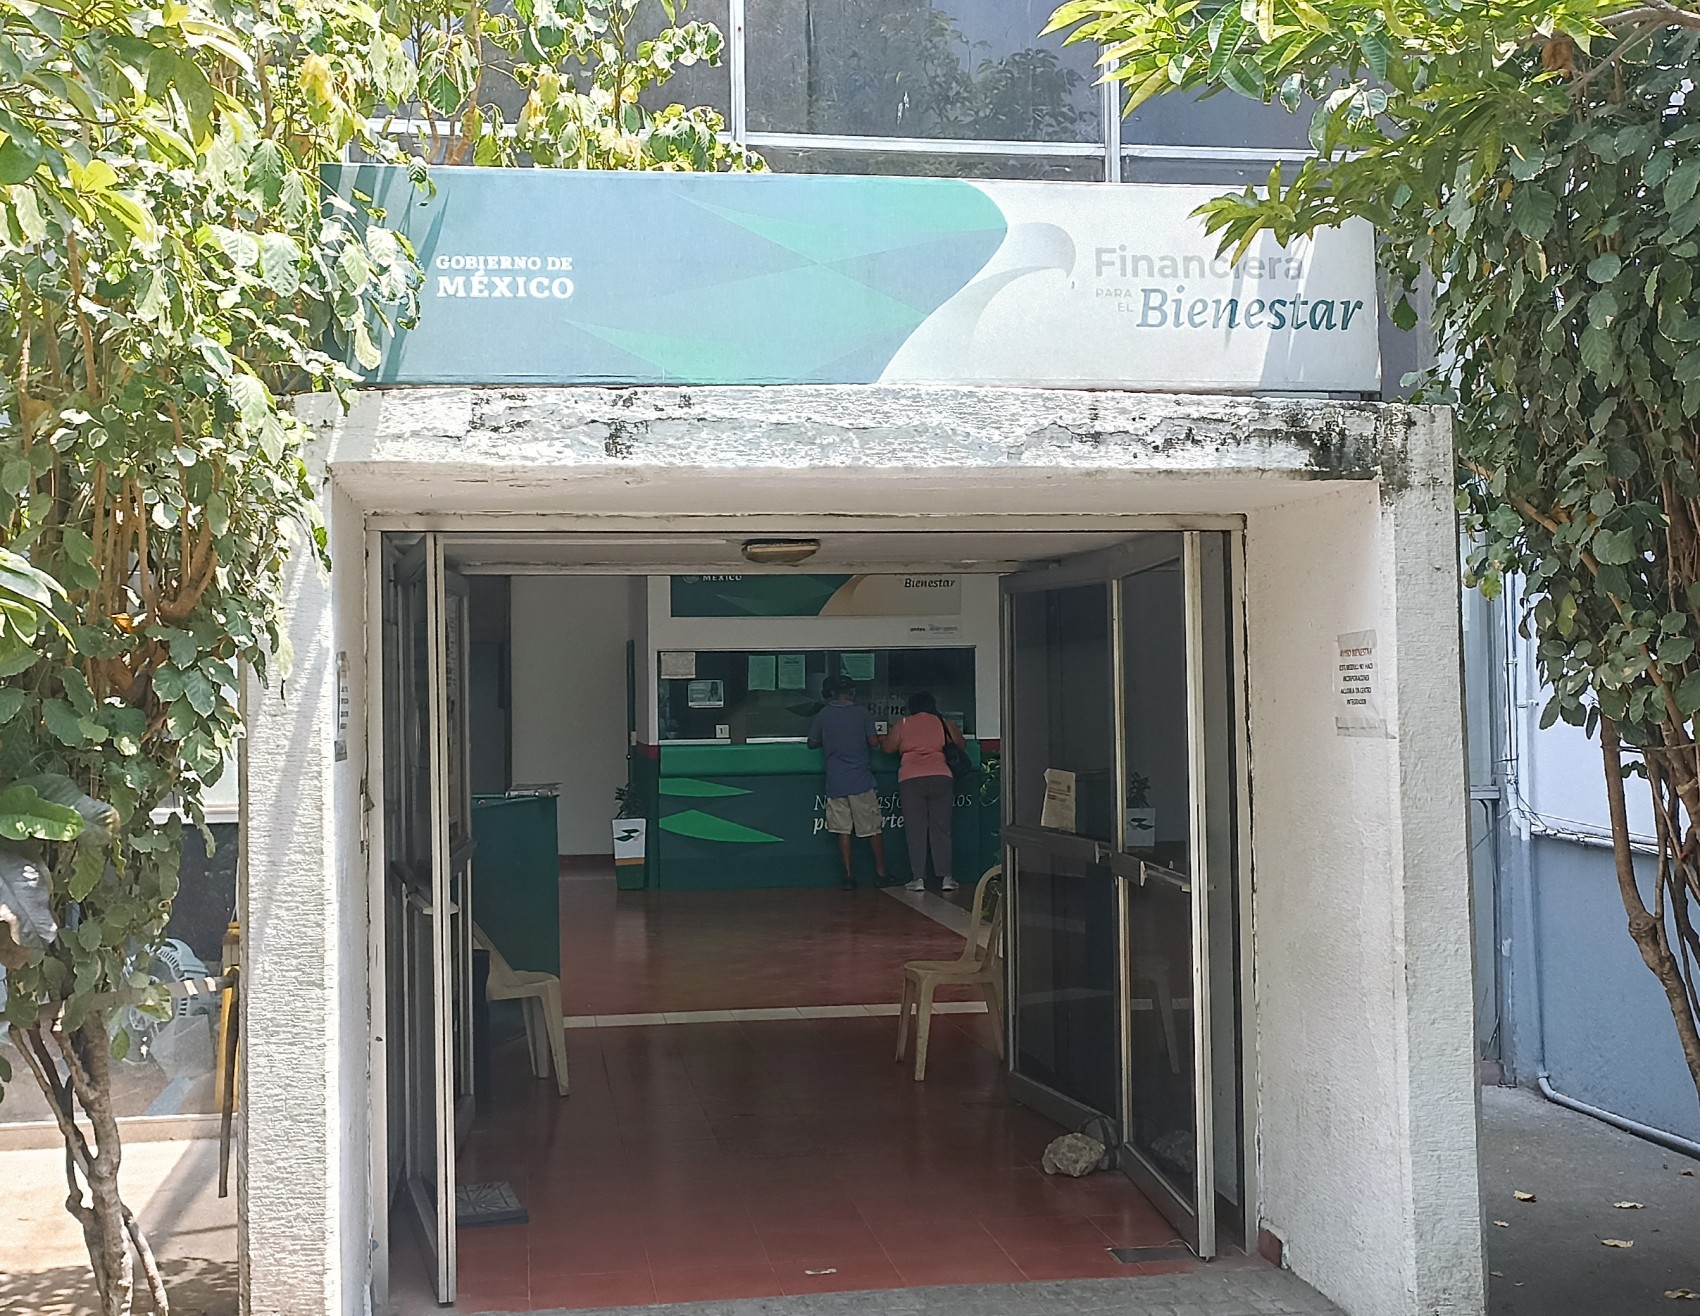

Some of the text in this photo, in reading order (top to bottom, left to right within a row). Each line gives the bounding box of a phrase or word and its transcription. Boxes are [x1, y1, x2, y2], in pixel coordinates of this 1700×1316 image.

[435, 255, 573, 270] GOBIERNO DE
[1095, 244, 1304, 280] Financiera
[436, 269, 575, 299] MÉXICO
[1096, 288, 1132, 298] PARA
[1118, 302, 1134, 312] EL
[1136, 285, 1364, 331] Bienestar
[904, 578, 956, 588] Bienestar
[877, 724, 883, 732] 2
